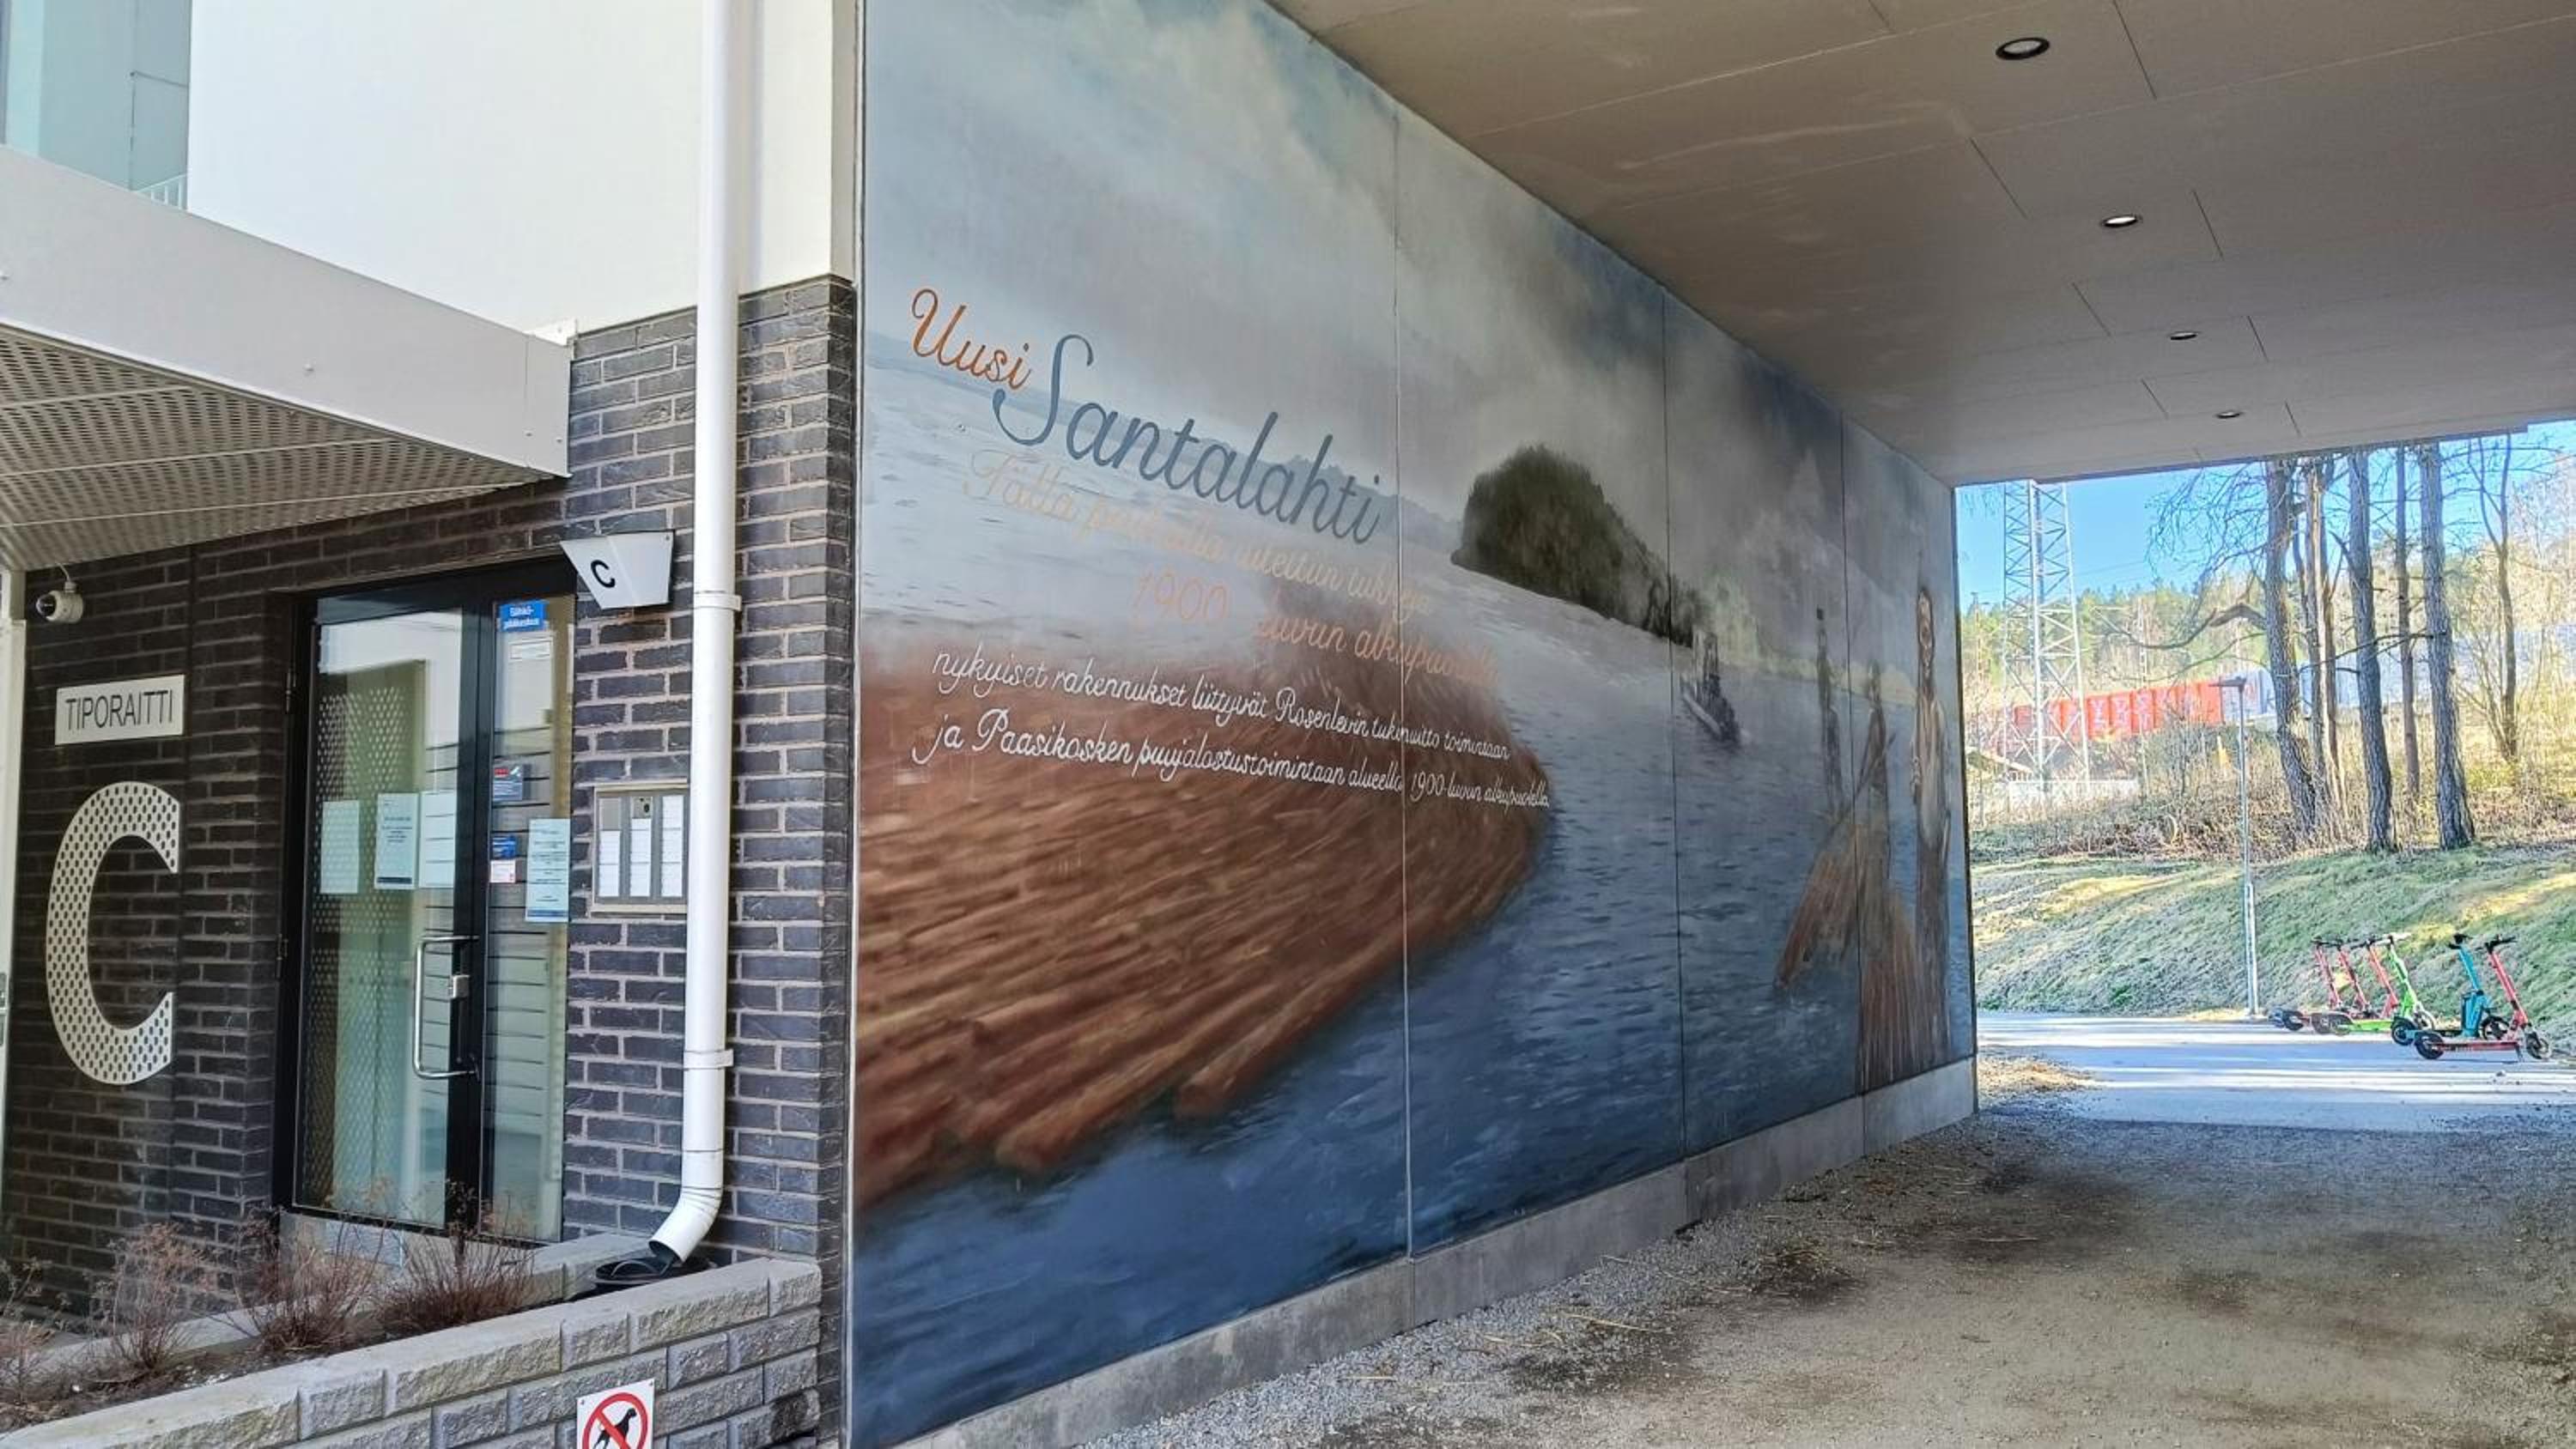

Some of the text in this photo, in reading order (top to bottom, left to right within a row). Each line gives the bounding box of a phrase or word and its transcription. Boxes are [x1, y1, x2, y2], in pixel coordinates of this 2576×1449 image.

[911, 288, 1381, 545] Uusi Santalahti
[590, 560, 616, 588] C
[65, 689, 173, 731] TIPORAITTI
[932, 641, 1048, 698] nykyiset
[1050, 658, 1188, 708] rakennukset
[1191, 673, 1268, 727] liittyvät
[912, 714, 966, 765] ja
[971, 708, 1134, 764] Paasikosken
[46, 780, 180, 1085] C
